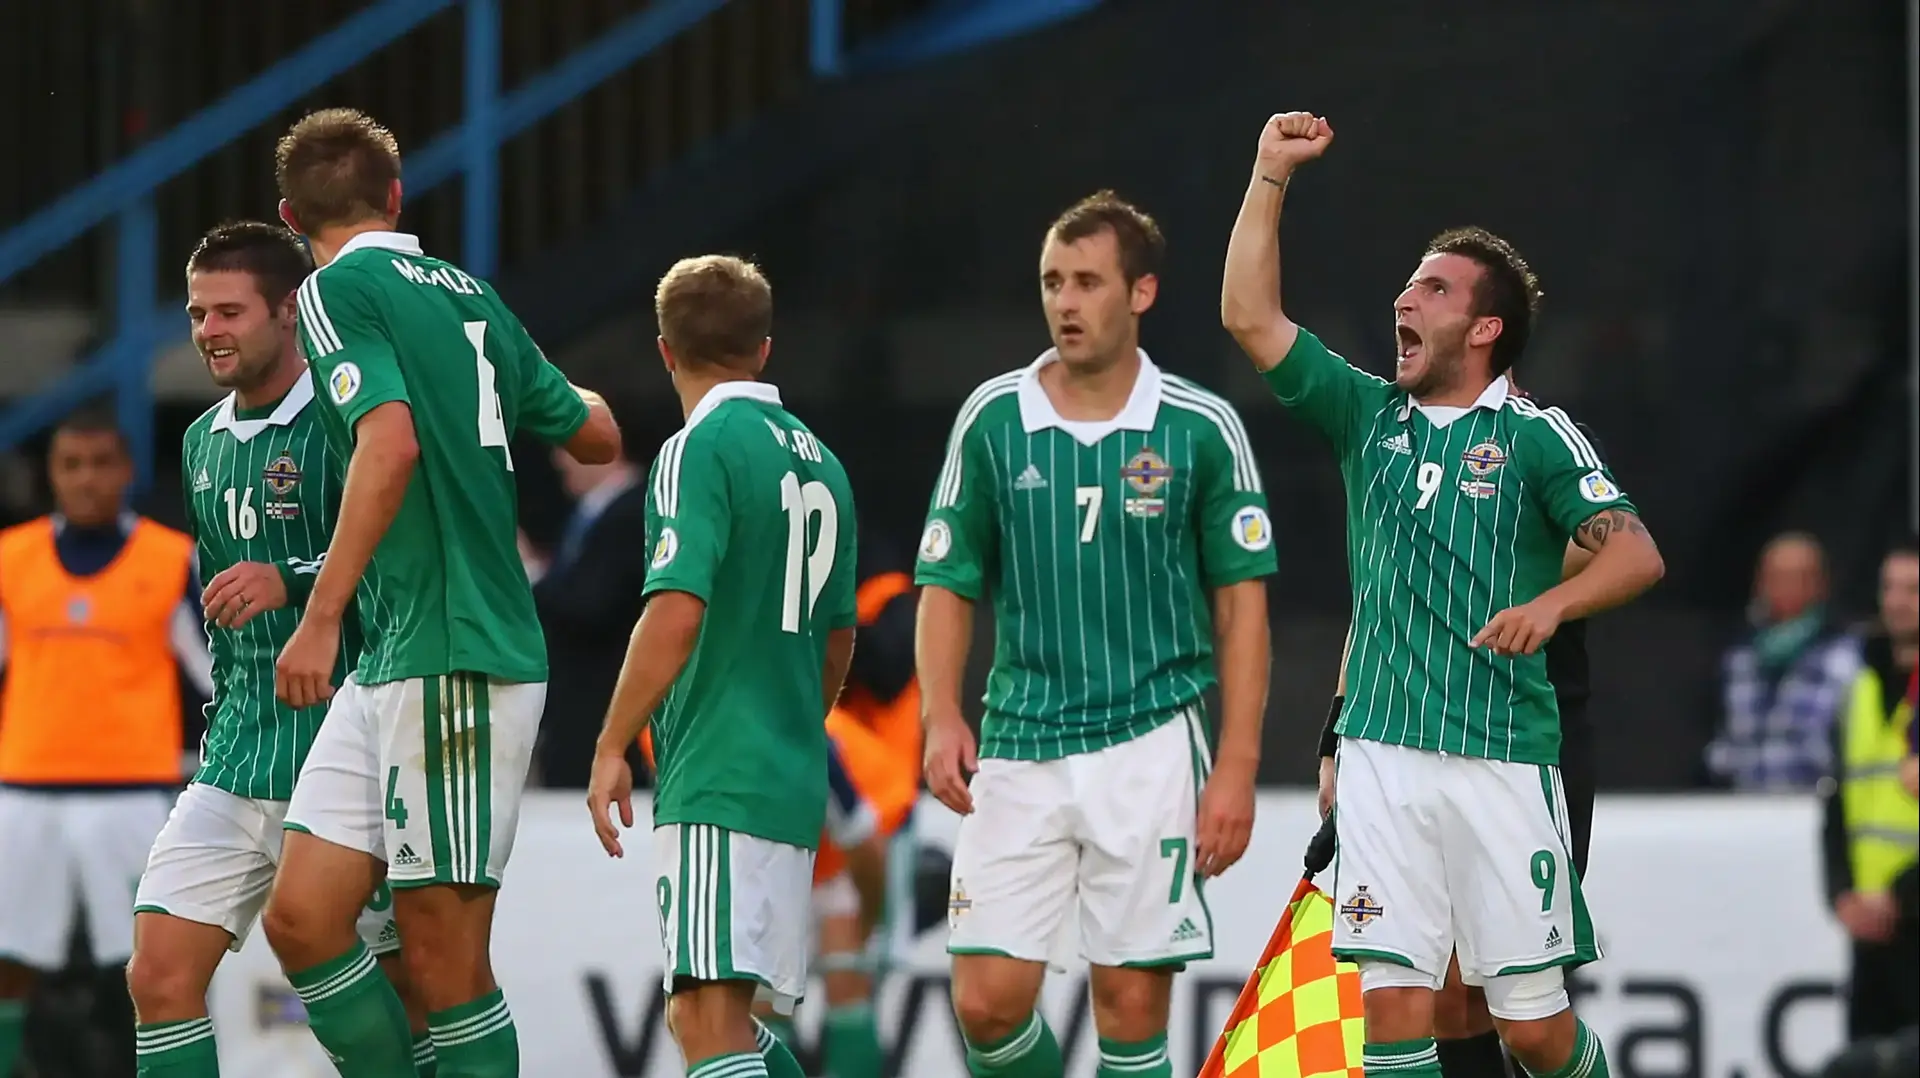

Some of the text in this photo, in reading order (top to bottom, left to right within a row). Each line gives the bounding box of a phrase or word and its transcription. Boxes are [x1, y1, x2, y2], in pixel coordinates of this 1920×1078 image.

[764, 418, 822, 463] WRD
[224, 487, 258, 540] 16
[1075, 486, 1103, 543] 7
[1416, 462, 1443, 510] 9
[780, 470, 838, 636] 19
[385, 766, 408, 829] 4
[1161, 838, 1187, 904] 7
[1530, 849, 1556, 912] 9
